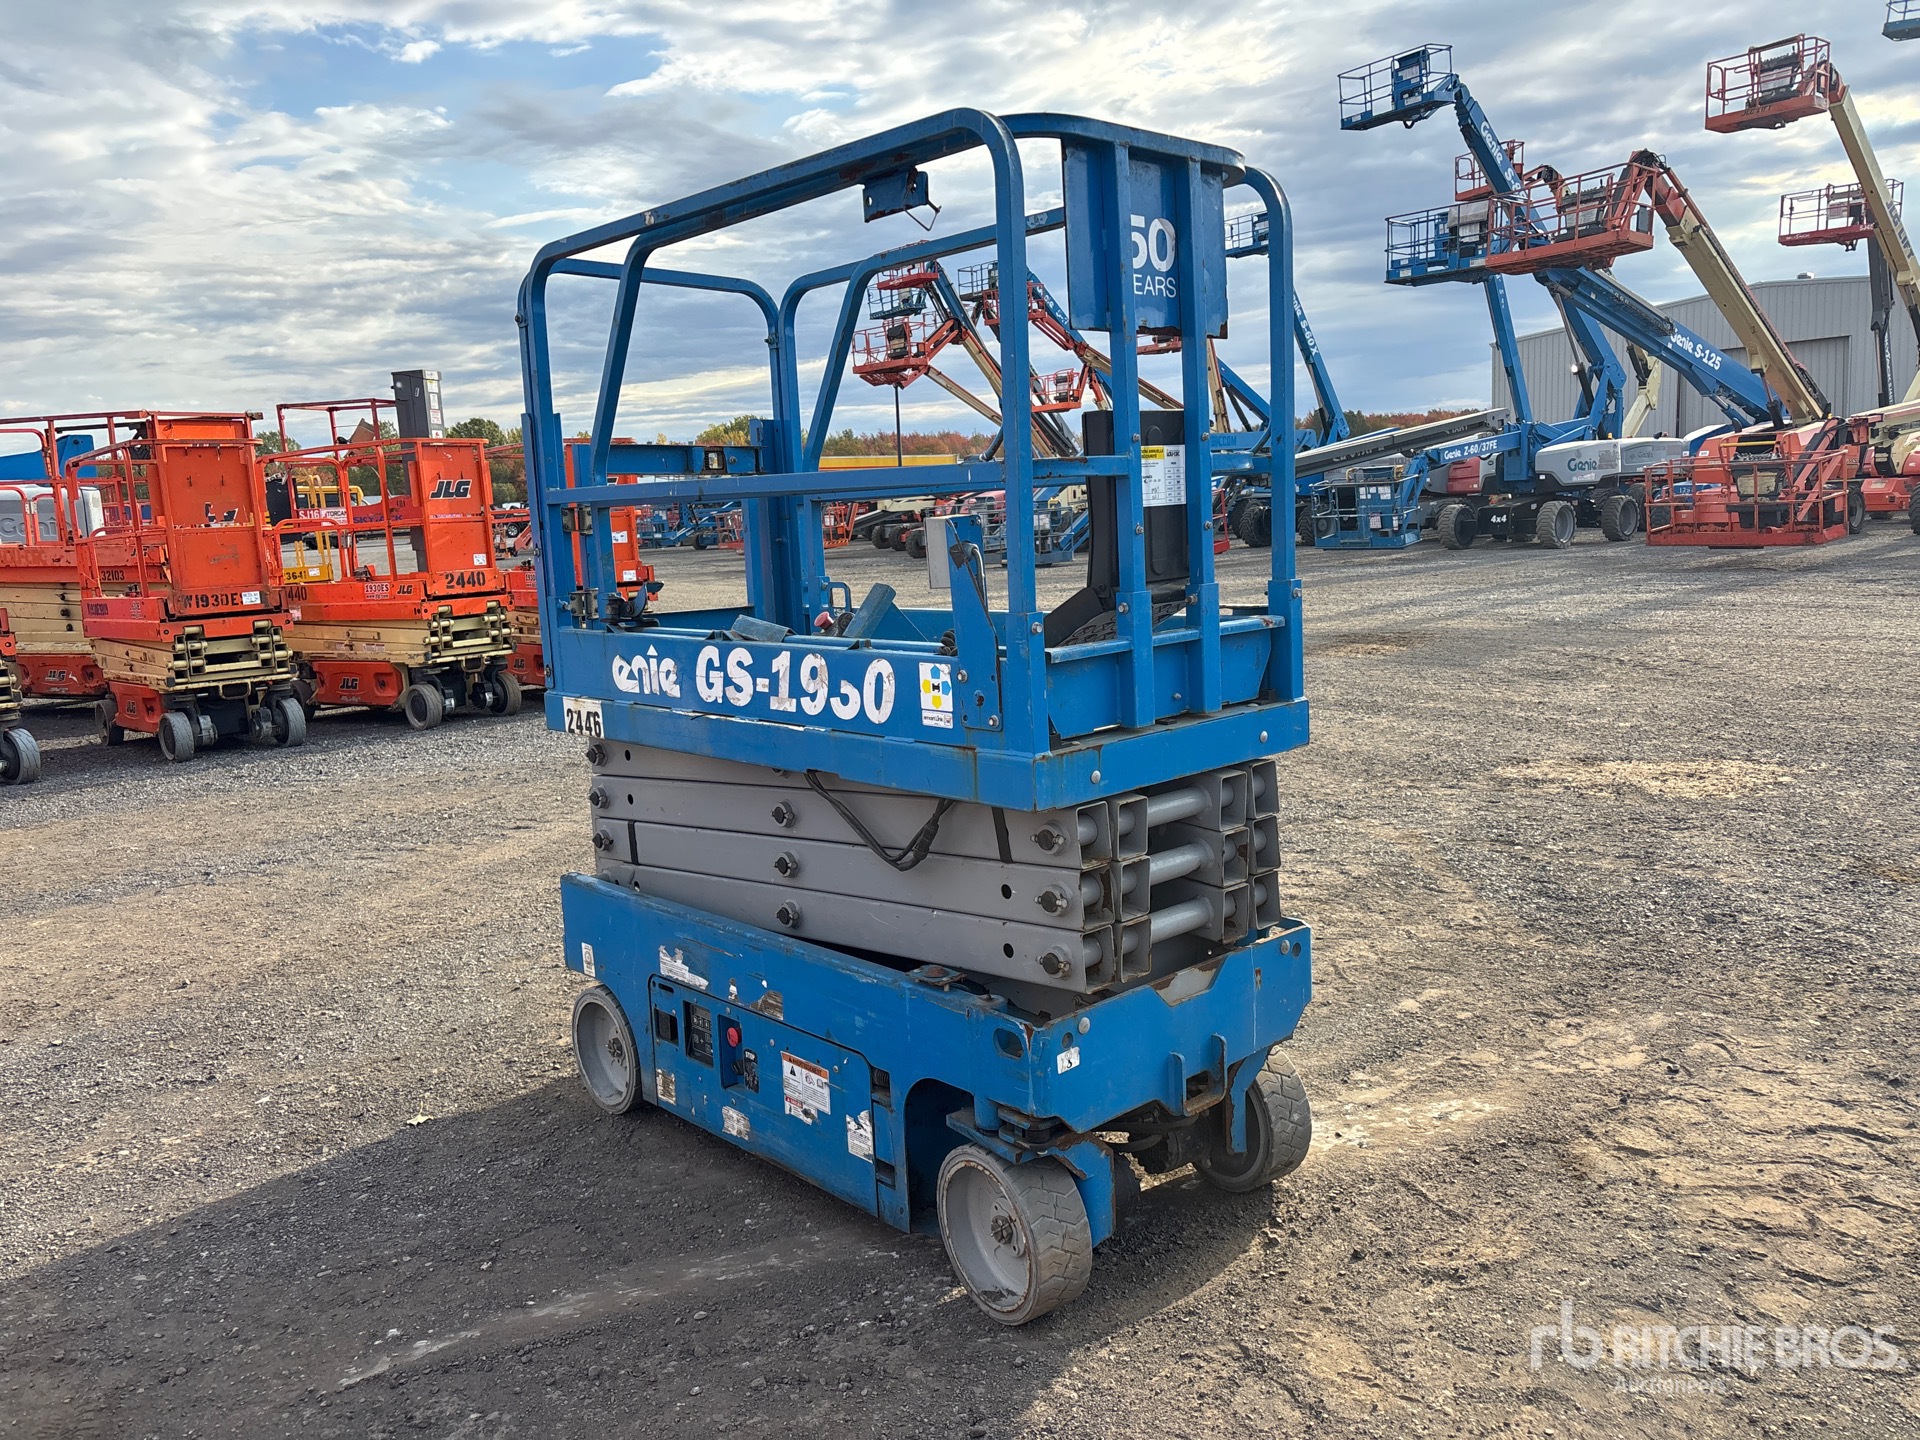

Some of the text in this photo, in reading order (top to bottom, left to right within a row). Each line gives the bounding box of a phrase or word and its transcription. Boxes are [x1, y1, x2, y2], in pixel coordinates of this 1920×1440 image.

[1481, 121, 1503, 165] Genie
[1886, 201, 1915, 259] JLG LIFT
[1130, 214, 1176, 273] 50
[1133, 274, 1177, 298] EARS
[1301, 320, 1318, 355] S-60X
[1694, 344, 1722, 370] S-125
[1444, 439, 1498, 460] Genie Z-60/37FE
[1567, 458, 1598, 471] Genie
[429, 479, 471, 499] JLG
[1490, 514, 1507, 523] 4x4
[365, 583, 389, 592] 1930ES
[397, 584, 413, 595] JLG
[445, 571, 486, 589] 2440
[288, 587, 307, 601] 440
[612, 644, 681, 698] enie
[339, 677, 359, 690] JLG
[566, 708, 602, 738] 2446
